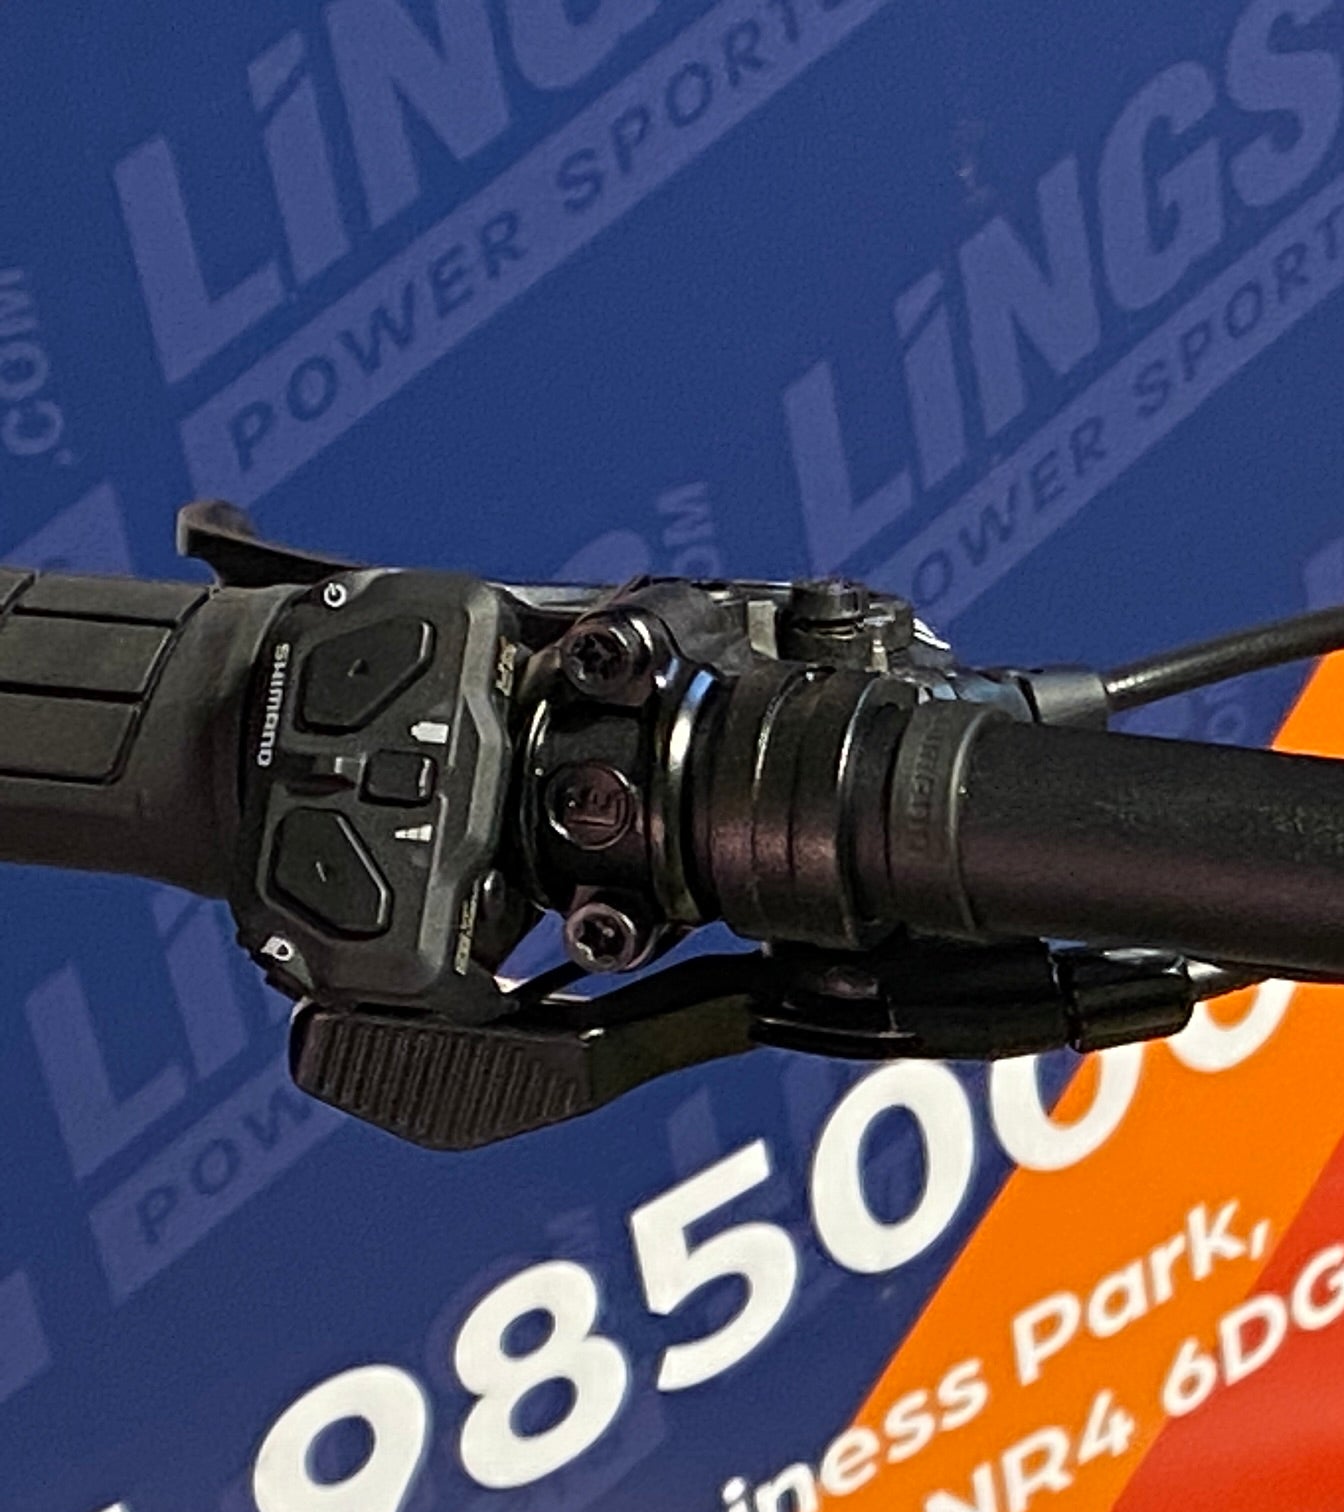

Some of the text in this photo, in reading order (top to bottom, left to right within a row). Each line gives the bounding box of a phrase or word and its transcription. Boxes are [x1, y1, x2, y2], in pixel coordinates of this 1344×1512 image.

[226, 210, 530, 472] POWER
[911, 416, 1112, 606] OWER
[256, 642, 291, 768] SHIMANO
[1011, 1200, 1273, 1386] Park,
